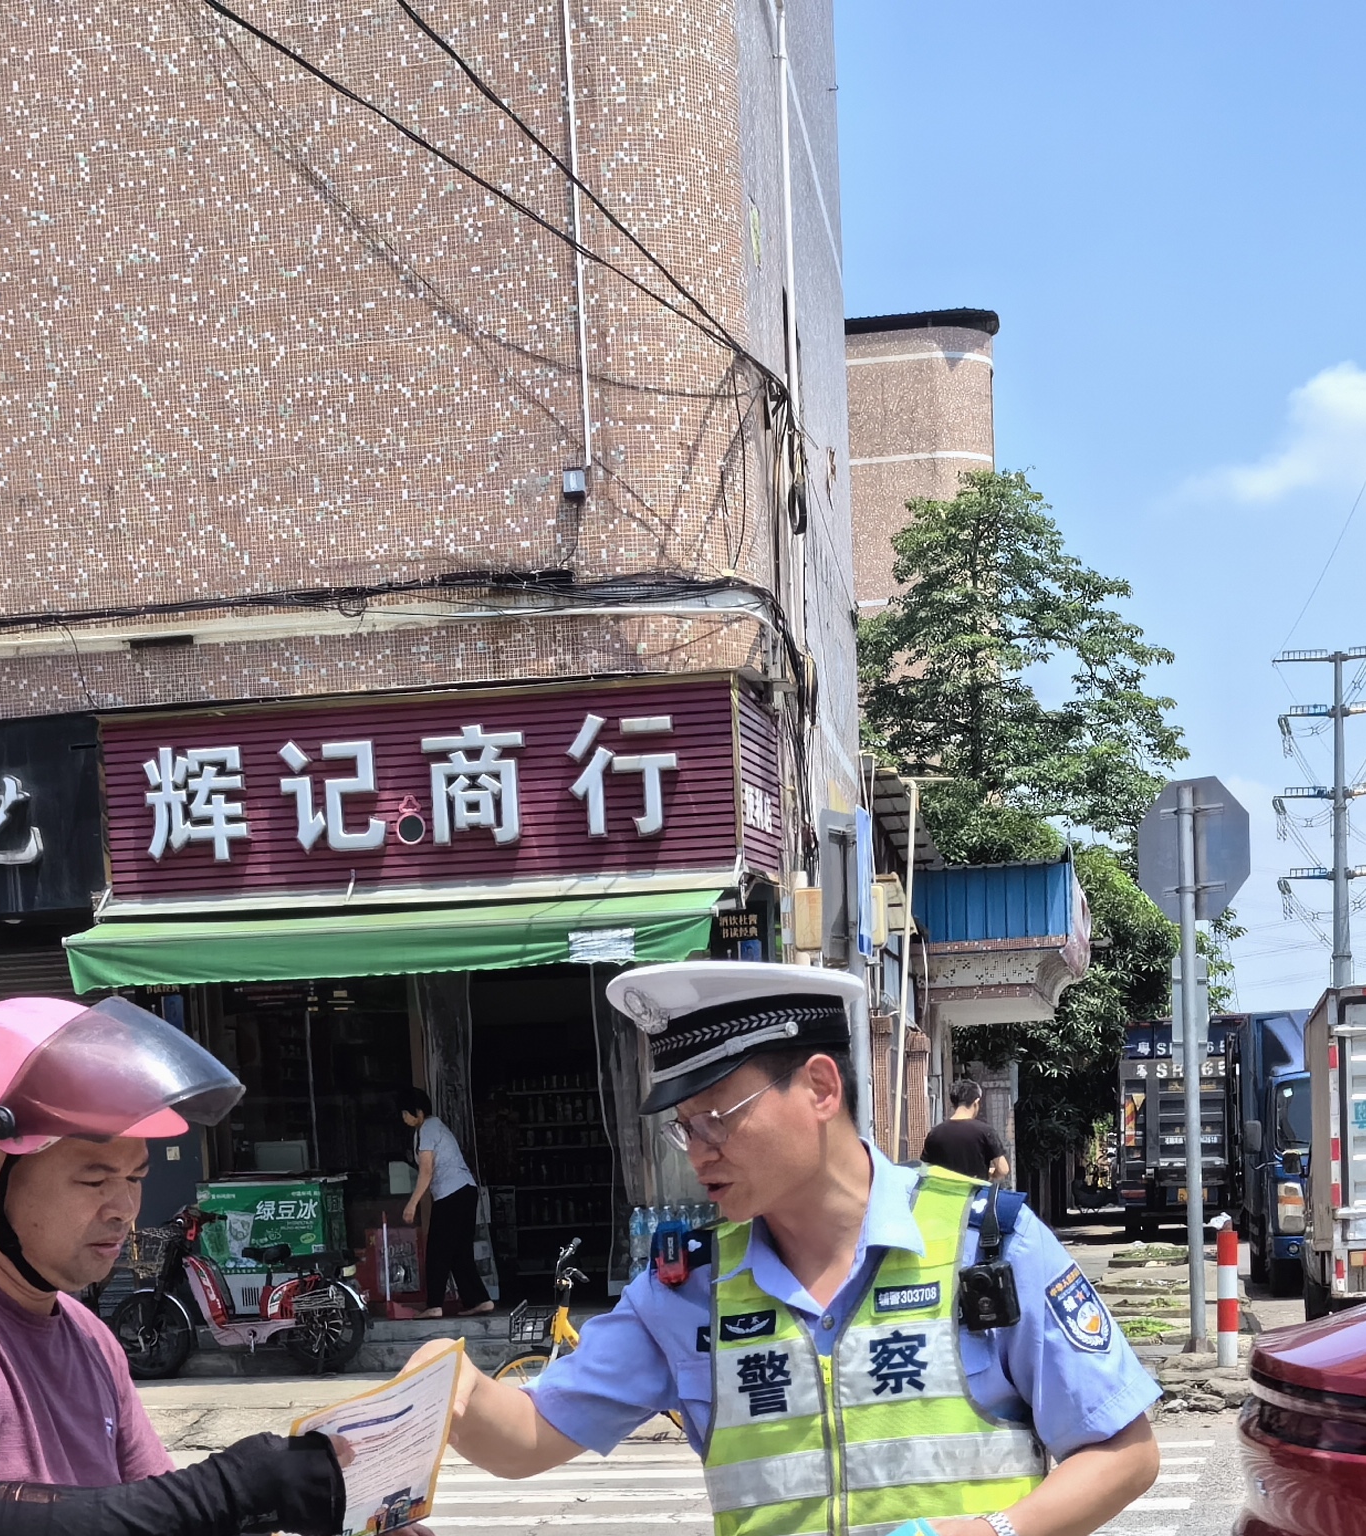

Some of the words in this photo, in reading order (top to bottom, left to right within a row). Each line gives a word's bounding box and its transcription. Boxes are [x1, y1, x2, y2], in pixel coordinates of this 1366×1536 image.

[143, 713, 678, 863] 辉记商行
[255, 1199, 319, 1221] 绿豆冰
[737, 1329, 929, 1417] 警察
